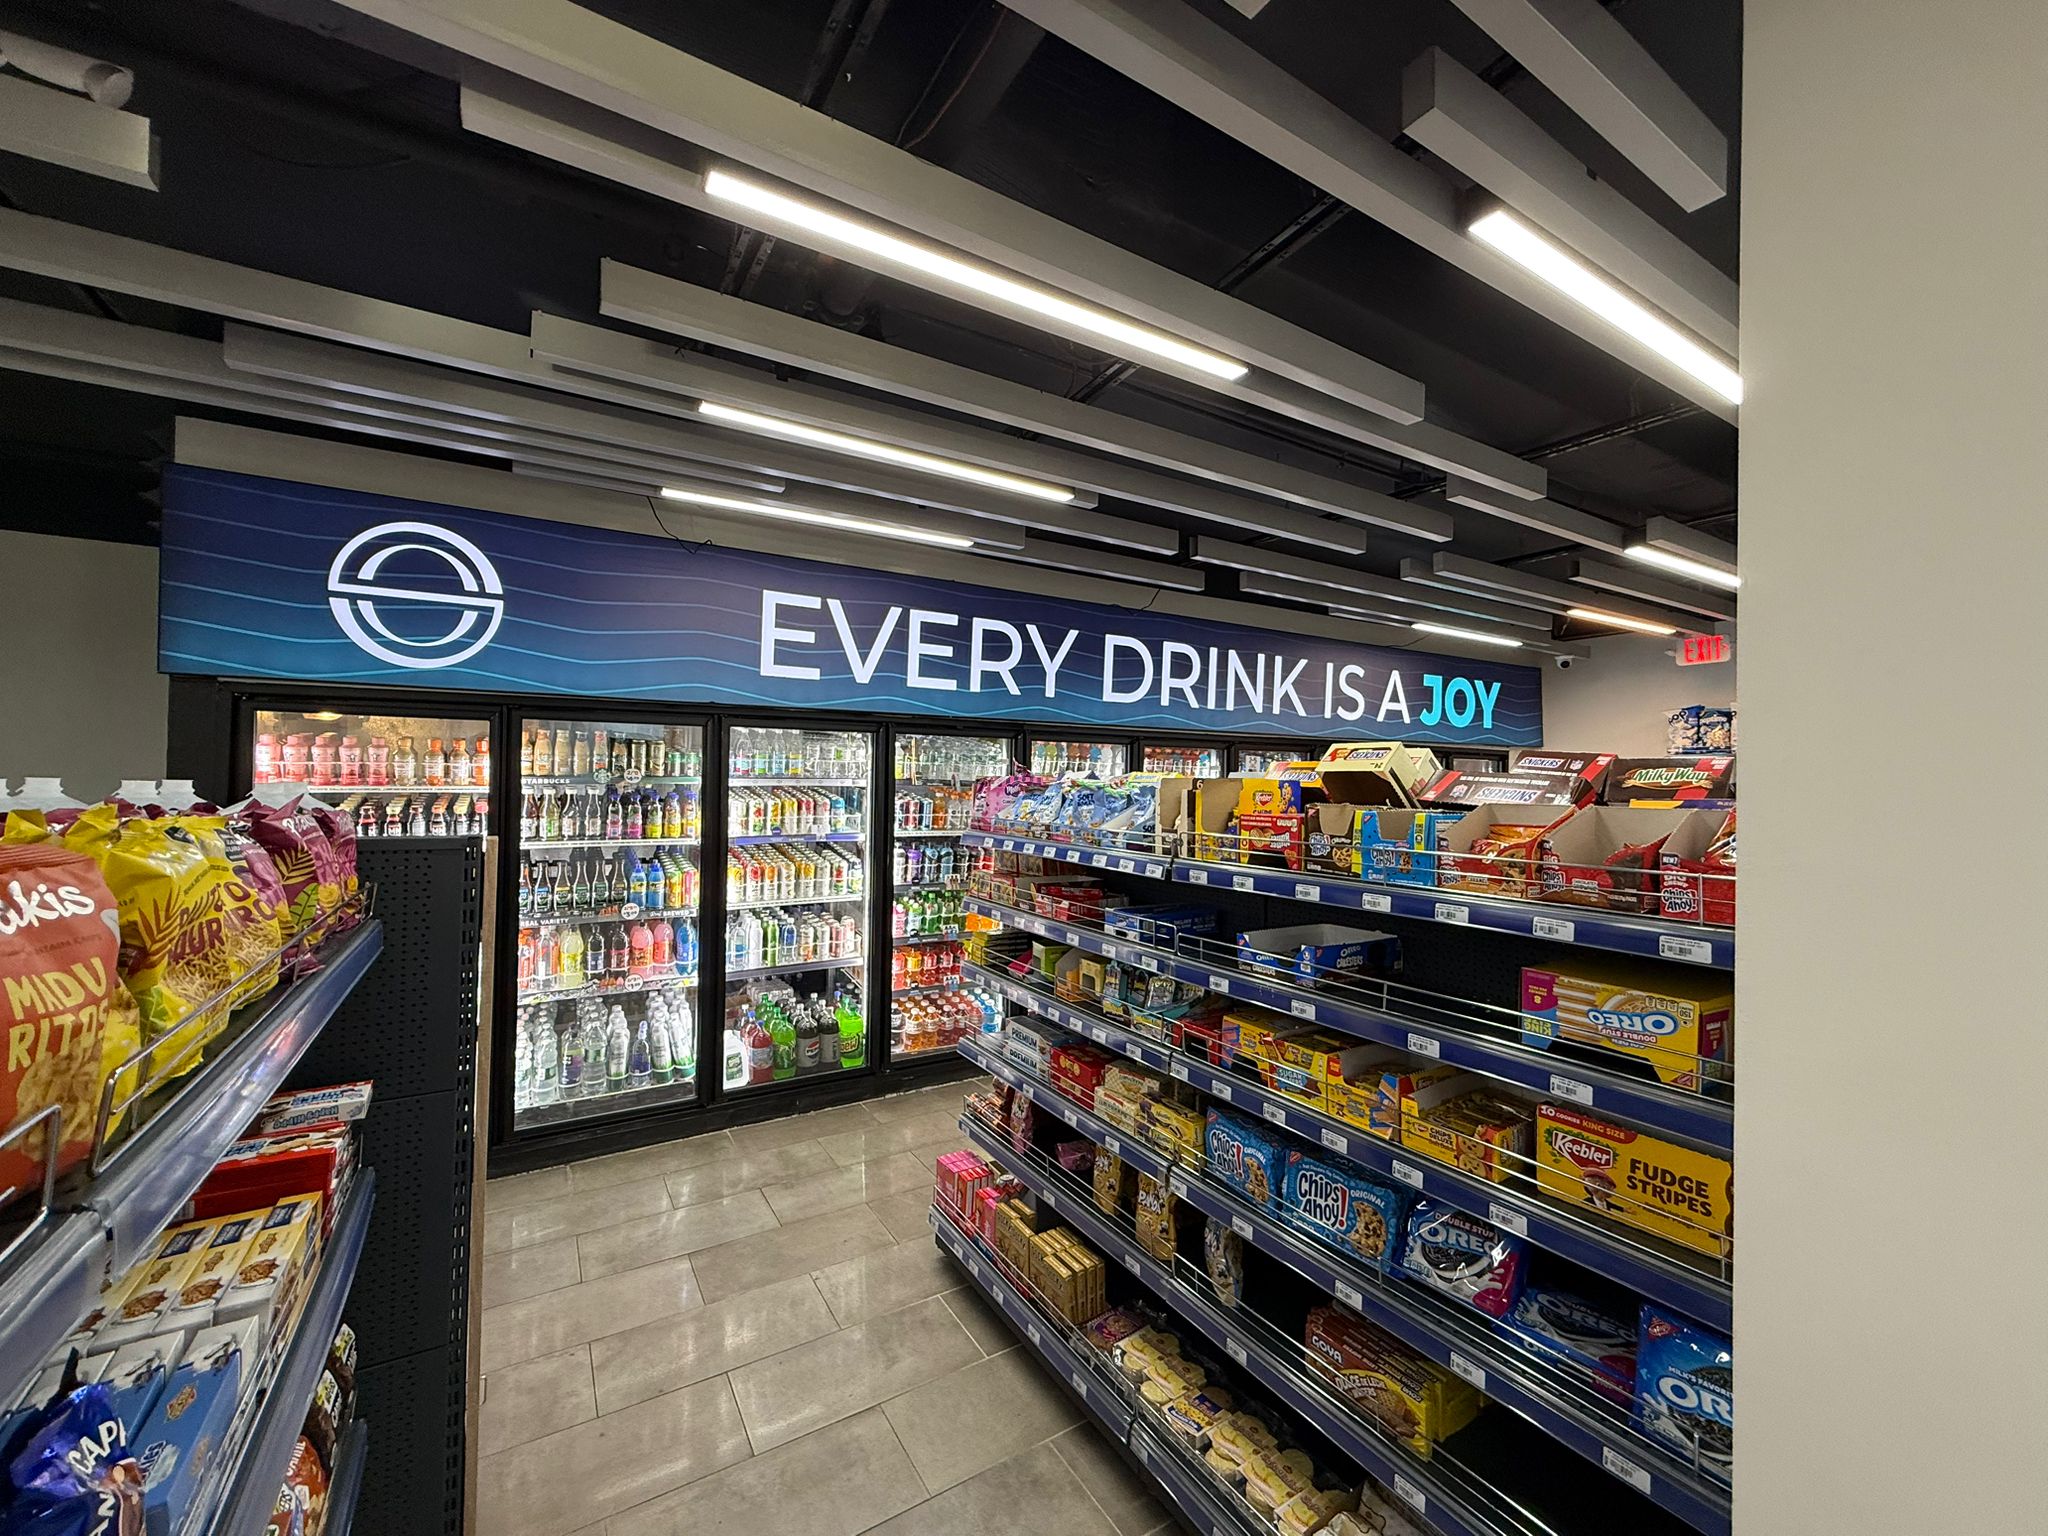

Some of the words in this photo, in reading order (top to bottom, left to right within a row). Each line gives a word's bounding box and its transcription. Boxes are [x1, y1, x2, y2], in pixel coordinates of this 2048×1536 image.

[760, 589, 1079, 698] EVERY
[1102, 634, 1307, 717] DRINK
[1323, 662, 1365, 721] IS
[1376, 670, 1410, 724] A
[1419, 673, 1501, 729] JOY
[1684, 635, 1723, 663] EXIT
[1521, 757, 1561, 768] SNICKERS
[1477, 787, 1537, 803] SNICKERS
[1523, 1022, 1551, 1036] KING
[1588, 1009, 1678, 1035] OREO
[1622, 1032, 1657, 1043] DOUBLE
[1430, 1127, 1453, 1140] CHIPS
[1540, 1104, 1556, 1117] 10
[1582, 1119, 1605, 1133] KING
[1605, 1126, 1626, 1140] SIZE
[1210, 1130, 1236, 1158] Chips
[1554, 1131, 1611, 1164] Keebler
[1298, 1171, 1341, 1201] Chips
[1629, 1158, 1710, 1200] FUDGE
[1302, 1184, 1349, 1229] Ahoy!
[1350, 1190, 1386, 1210] ORIGINAL
[1626, 1175, 1713, 1218] STRIPES
[1434, 1212, 1472, 1231] DOUBLE
[1311, 1334, 1344, 1365] GOYA
